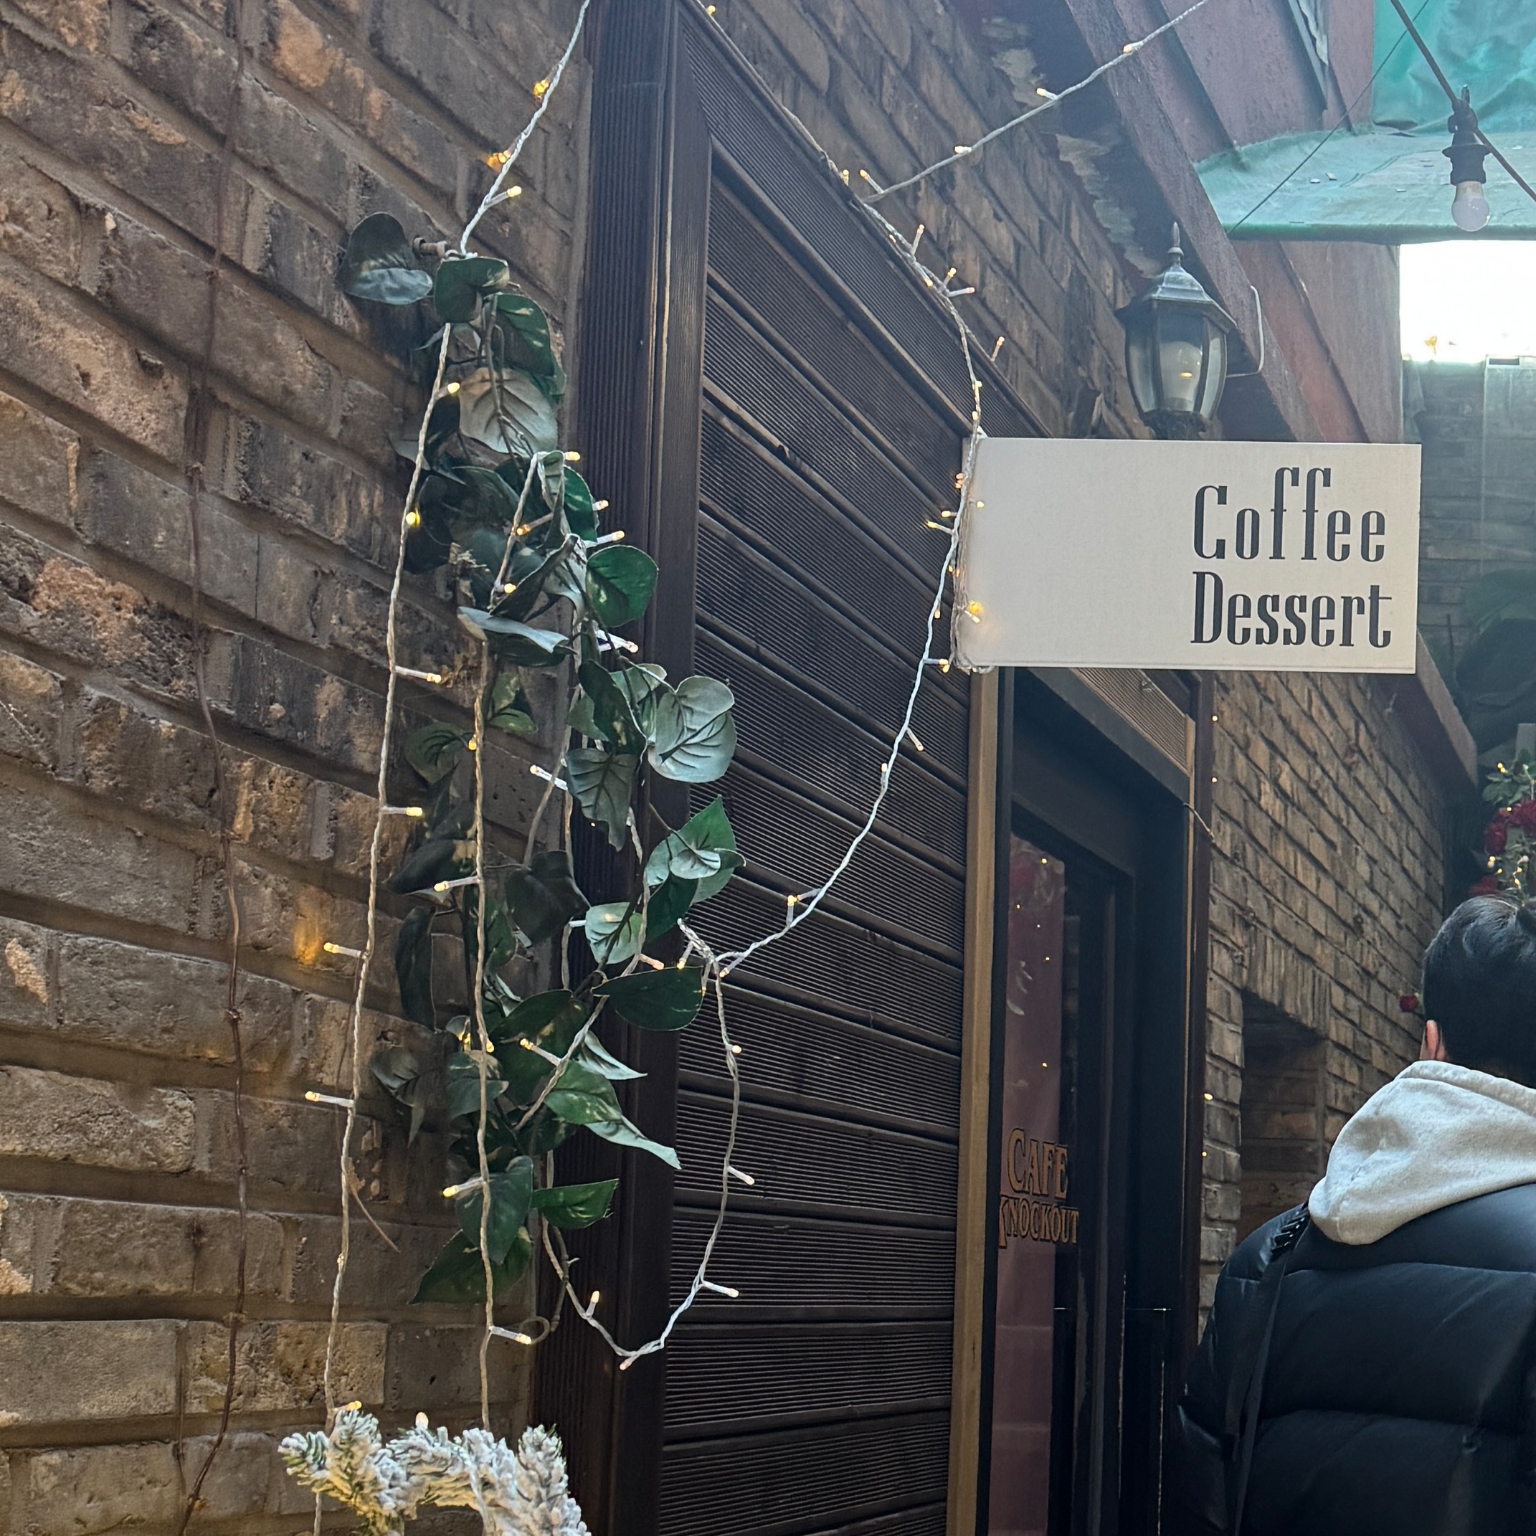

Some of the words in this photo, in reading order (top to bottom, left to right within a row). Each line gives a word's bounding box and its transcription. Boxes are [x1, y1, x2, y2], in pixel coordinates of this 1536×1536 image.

[1193, 467, 1387, 563] Coffee
[1190, 571, 1393, 649] Dessert
[1007, 1127, 1069, 1199] CAFE
[998, 1193, 1080, 1249] KNOCKOUT
